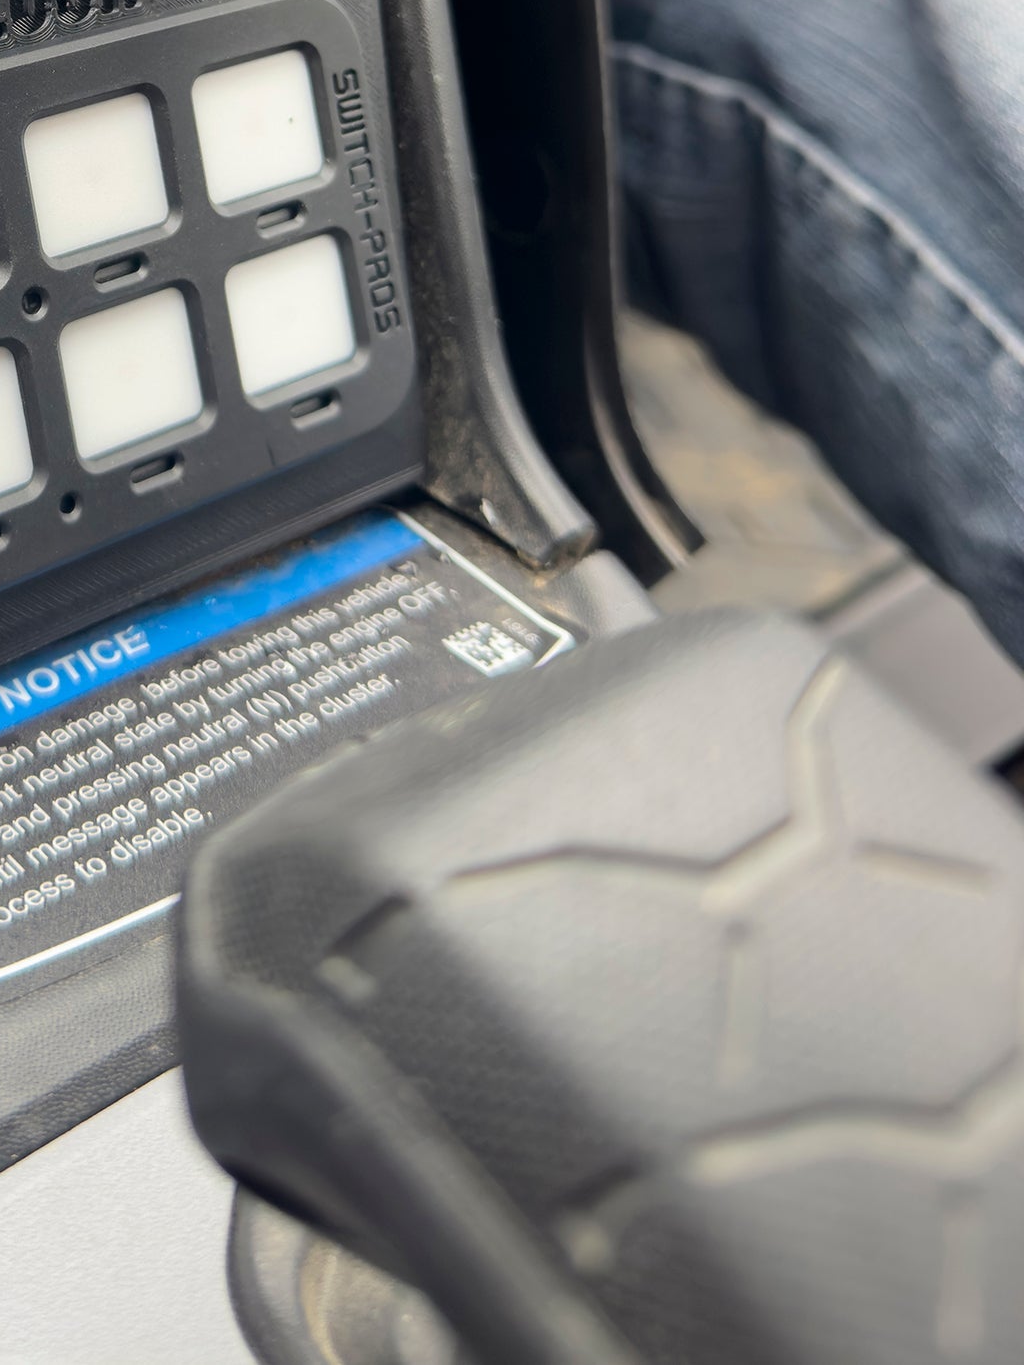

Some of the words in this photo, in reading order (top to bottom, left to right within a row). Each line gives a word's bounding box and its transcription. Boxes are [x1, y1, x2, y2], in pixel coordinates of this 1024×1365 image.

[332, 68, 401, 335] SWITCH-PROS
[24, 738, 113, 791] neutral
[114, 713, 176, 747] state
[173, 695, 211, 718] by
[207, 658, 296, 700] turning
[287, 642, 330, 663] the
[329, 608, 404, 644] engine
[36, 698, 147, 750] damage,
[140, 658, 222, 698] before
[218, 625, 298, 664] towing
[291, 608, 338, 633] this
[52, 754, 166, 818] pressing
[163, 708, 249, 759] neutral
[246, 690, 294, 720] (N)
[288, 636, 413, 703] pushbutton
[27, 798, 147, 867] message
[150, 746, 253, 805] appears
[246, 733, 280, 751] in
[275, 712, 319, 736] the
[319, 674, 401, 716] cluster.
[74, 857, 107, 879] to
[111, 808, 214, 862] disable.
